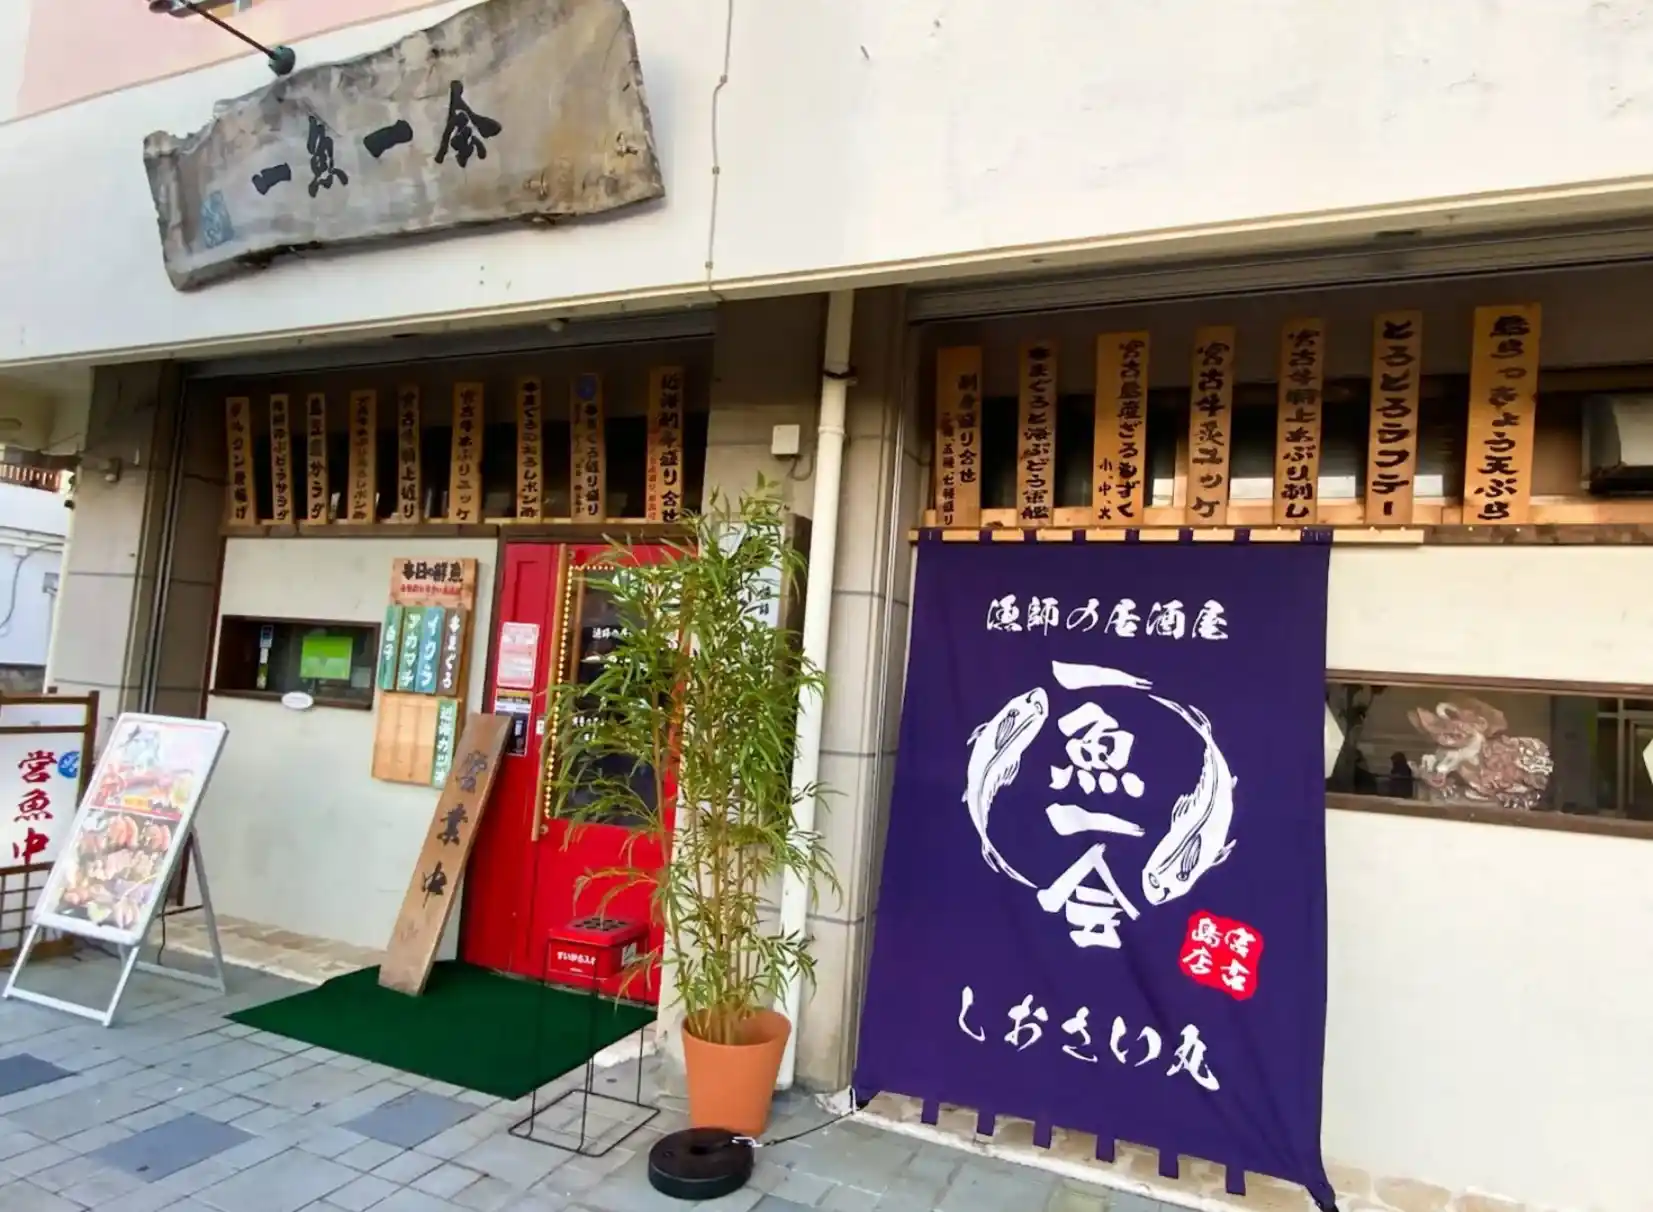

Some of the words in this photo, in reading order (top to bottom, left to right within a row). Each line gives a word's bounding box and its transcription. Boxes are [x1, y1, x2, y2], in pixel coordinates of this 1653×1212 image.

[252, 80, 502, 197] 一魚一会
[1372, 319, 1415, 516] とろとろラフテー
[1474, 315, 1530, 520] 島らっきょう天ぷら
[986, 594, 1229, 640] 漁師の居酒屋
[12, 750, 58, 865] 営魚中
[1036, 660, 1153, 949] 一魚一会
[960, 985, 1220, 1091] しおさい丸
